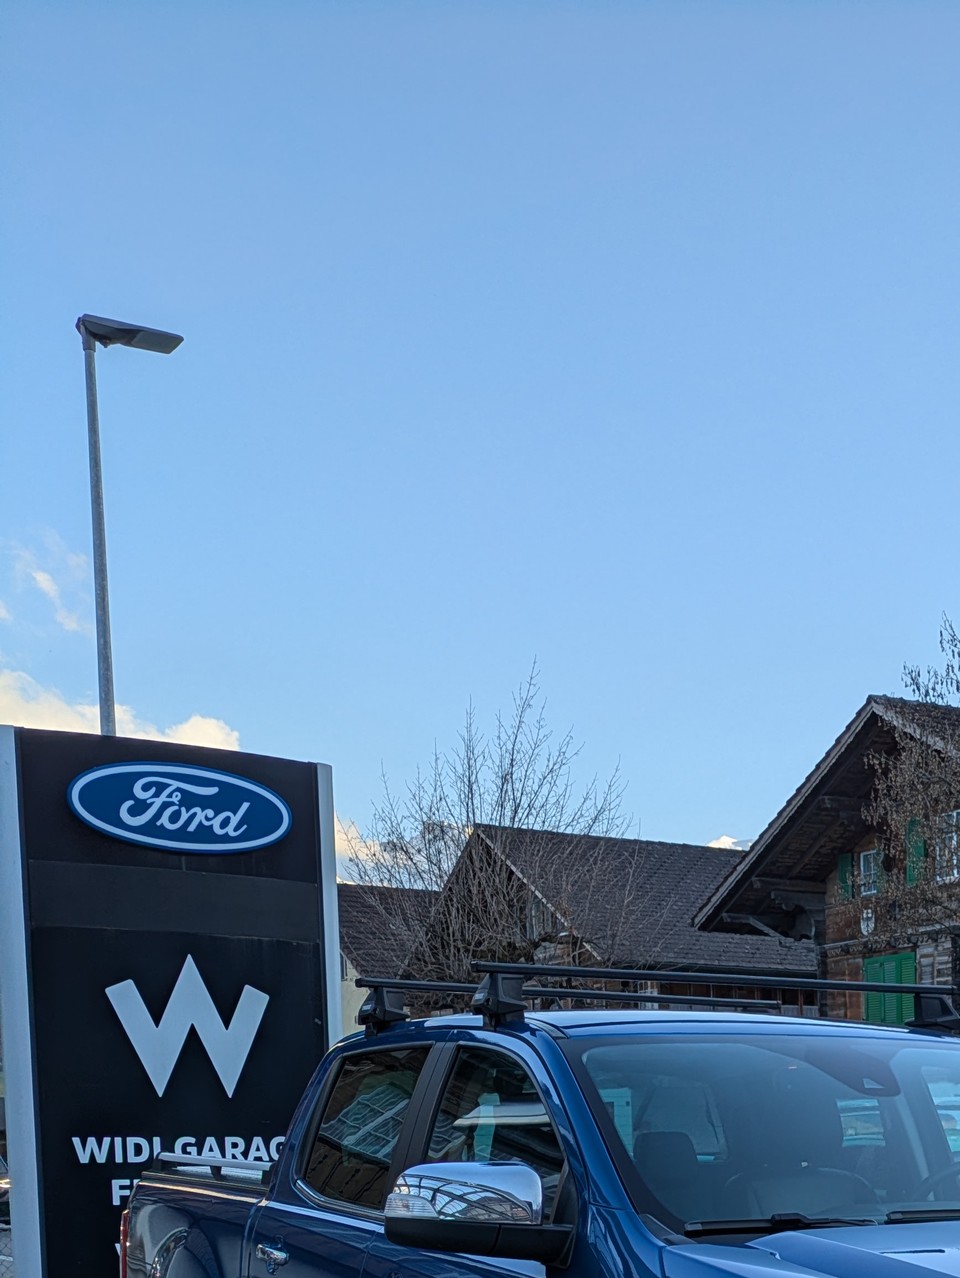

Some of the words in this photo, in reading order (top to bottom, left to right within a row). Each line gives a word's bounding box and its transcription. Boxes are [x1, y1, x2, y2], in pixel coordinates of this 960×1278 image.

[119, 776, 251, 837] Ford
[71, 1136, 160, 1164] WIDI
[174, 1136, 287, 1162] GARAG
